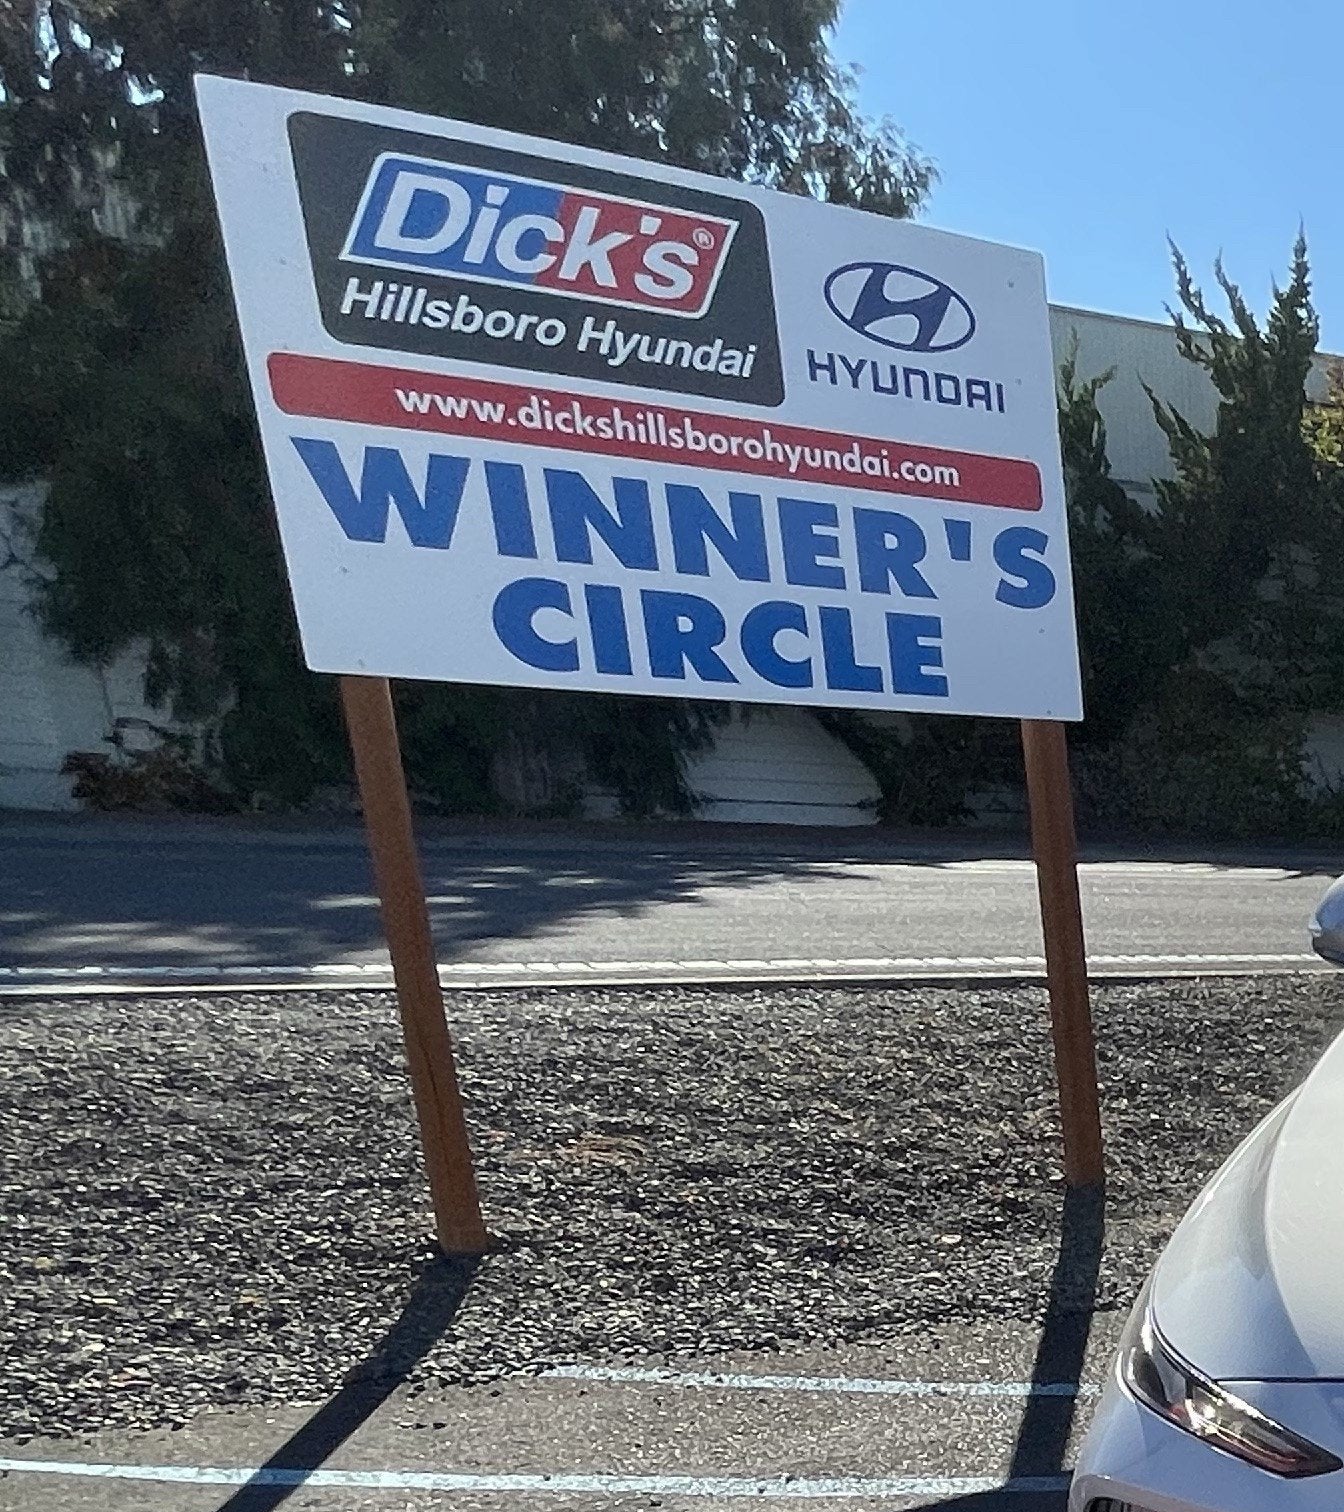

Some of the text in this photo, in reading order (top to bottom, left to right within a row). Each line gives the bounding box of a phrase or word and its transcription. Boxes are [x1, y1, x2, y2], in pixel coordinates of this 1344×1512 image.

[373, 170, 700, 300] Dick's
[339, 276, 758, 379] Hillsboro Hyundai
[806, 348, 1006, 414] HYUNDAI
[395, 386, 962, 487] www.dickshillsborohyundai.com
[288, 436, 1057, 610] WINNER'S
[491, 576, 950, 698] CIRCLE
